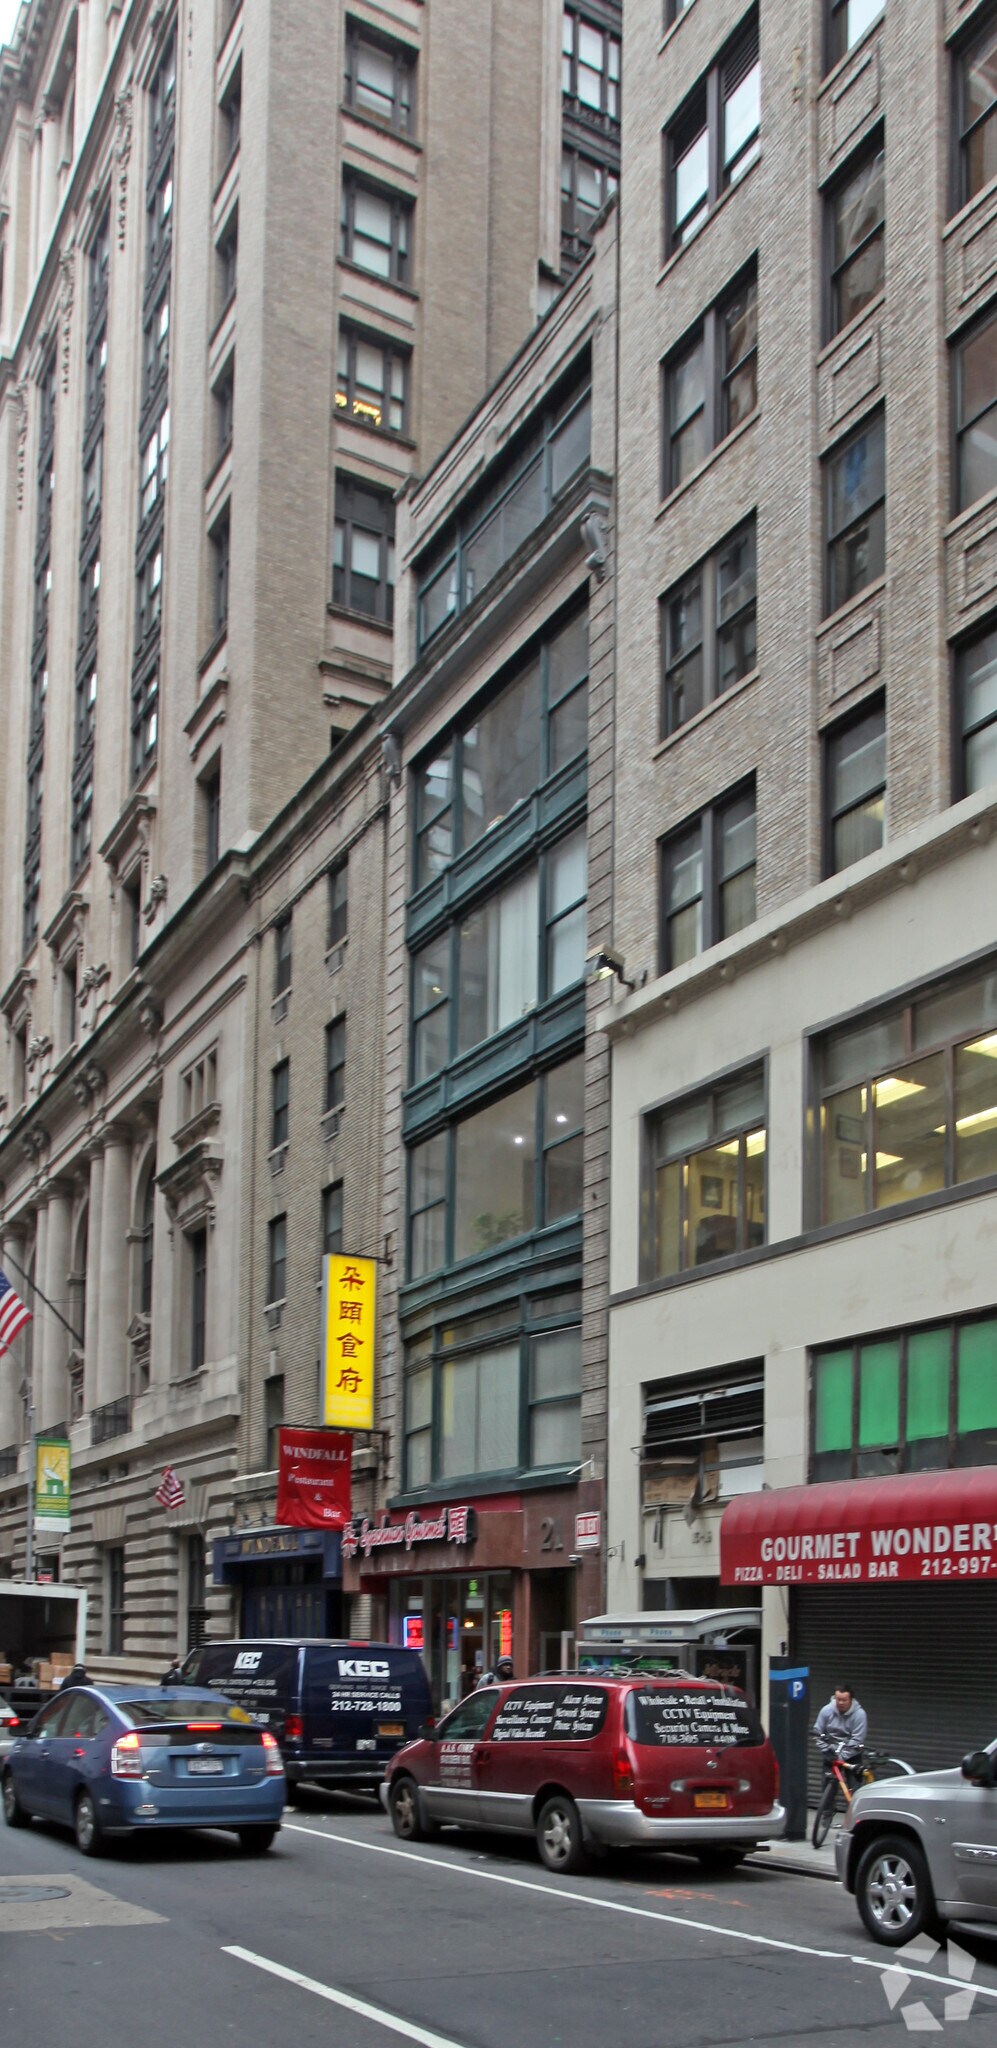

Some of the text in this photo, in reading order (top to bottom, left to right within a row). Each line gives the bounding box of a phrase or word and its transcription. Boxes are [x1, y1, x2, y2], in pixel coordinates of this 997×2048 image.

[283, 1445, 348, 1461] WINDFALL
[288, 1473, 334, 1487] Restaurant
[323, 1508, 341, 1518] Bar
[405, 1508, 446, 1550] Gourmet
[541, 1516, 563, 1551] 21
[760, 1532, 860, 1562] GOURMET
[734, 1566, 763, 1582] PIZZA
[776, 1565, 802, 1581] DELI
[818, 1563, 861, 1580] SALAD
[868, 1561, 899, 1578] BAR
[601, 1629, 622, 1637] Phone
[650, 1628, 672, 1637] Phone
[233, 1652, 263, 1669] KEC
[338, 1660, 390, 1677] KEC
[352, 1691, 379, 1699] SERVICE
[793, 1681, 803, 1698] P
[562, 1694, 604, 1706] Alarm System
[638, 1695, 678, 1706] Wholesale
[683, 1695, 707, 1705] Retail
[504, 1701, 555, 1713] CCTV Equipment
[495, 1714, 553, 1725] Surveillance Camera
[554, 1708, 601, 1720] Network System
[662, 1708, 737, 1722] CCTV Equipment
[553, 1720, 594, 1733] Phone System
[653, 1722, 689, 1735] Security
[690, 1722, 721, 1733] Camera
[730, 1723, 749, 1734] More
[493, 1728, 547, 1740] Digital Video Recorder
